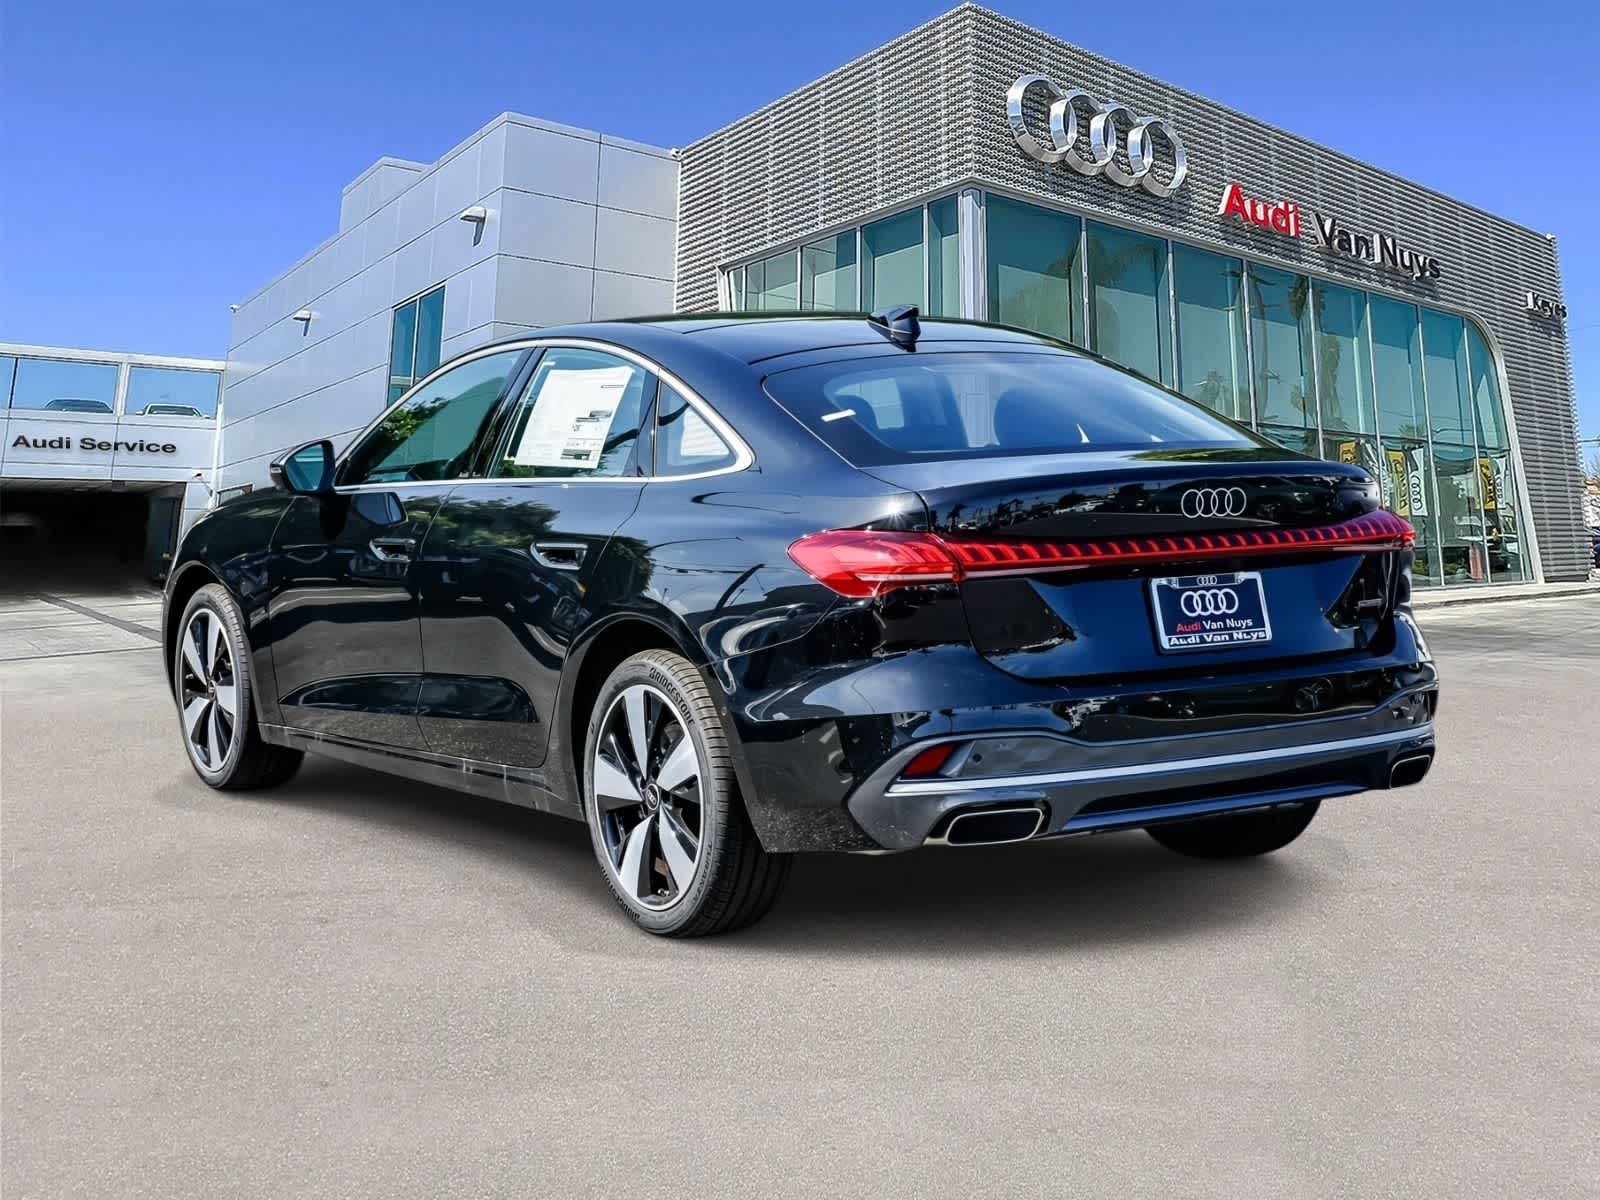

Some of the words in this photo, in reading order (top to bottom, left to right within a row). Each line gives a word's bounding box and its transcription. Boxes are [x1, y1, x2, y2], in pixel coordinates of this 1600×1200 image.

[1218, 182, 1301, 237] Audi
[1312, 213, 1370, 259] Van
[1374, 232, 1441, 281] Nuys
[12, 435, 71, 449] Audi
[79, 437, 177, 454] Service
[1176, 621, 1202, 633] Audi
[1202, 620, 1224, 630] Van
[1226, 618, 1253, 630] Nuys
[1169, 635, 1200, 646] Audi
[1203, 633, 1229, 643] Van
[648, 667, 696, 726] BRIDGESTONE
